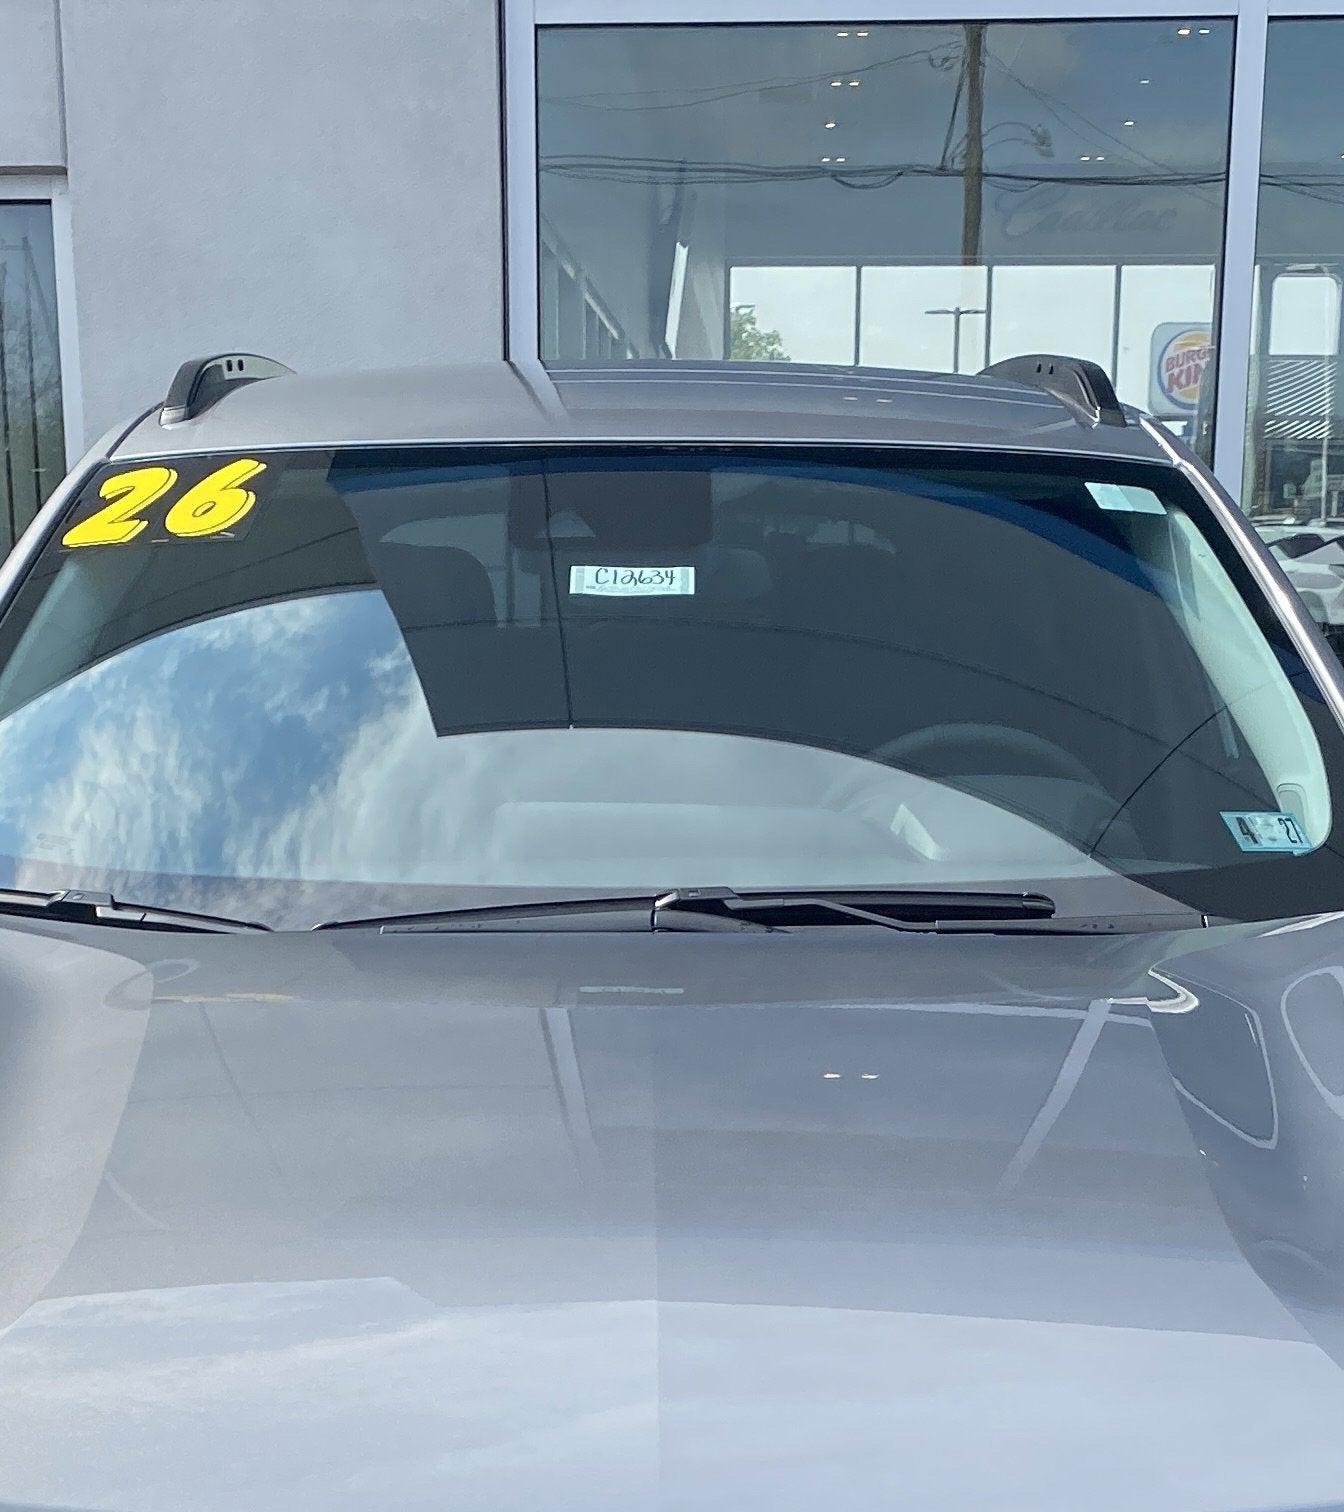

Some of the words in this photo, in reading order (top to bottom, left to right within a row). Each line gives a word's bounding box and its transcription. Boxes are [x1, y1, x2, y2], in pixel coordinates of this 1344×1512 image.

[1166, 347, 1211, 372] BURG
[62, 458, 267, 548] 26
[1277, 817, 1303, 844] 27
